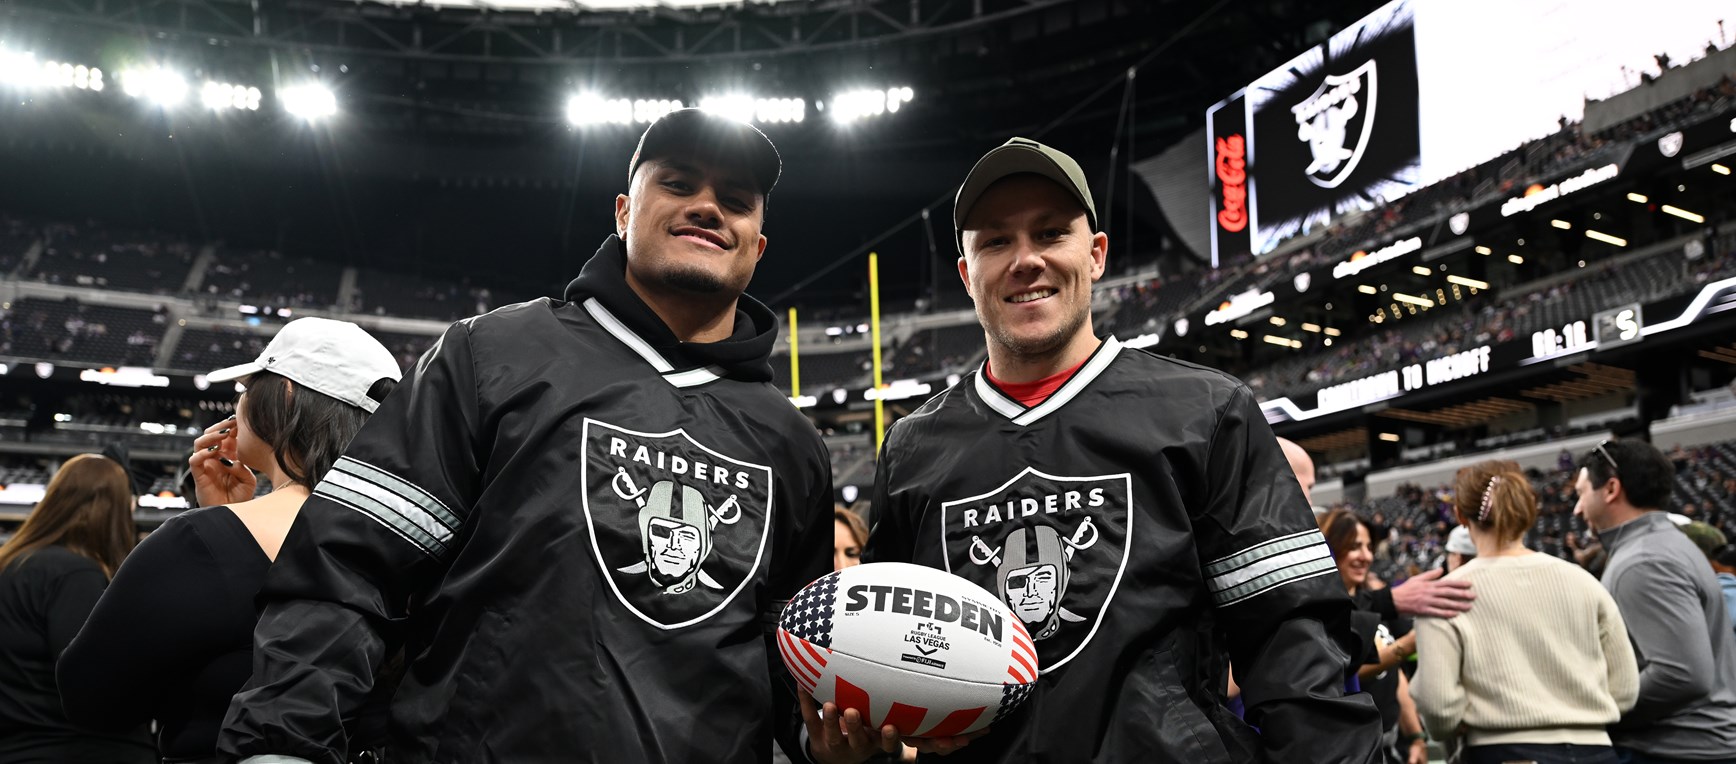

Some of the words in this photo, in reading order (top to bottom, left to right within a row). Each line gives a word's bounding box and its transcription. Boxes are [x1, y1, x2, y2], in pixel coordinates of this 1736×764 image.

[610, 436, 750, 489] RAIDERS
[963, 487, 1105, 528] RAIDERS
[845, 584, 1003, 643] STEEDEN
[904, 634, 922, 644] LAS
[922, 637, 950, 651] VEGAS
[927, 633, 946, 641] LEAGUE
